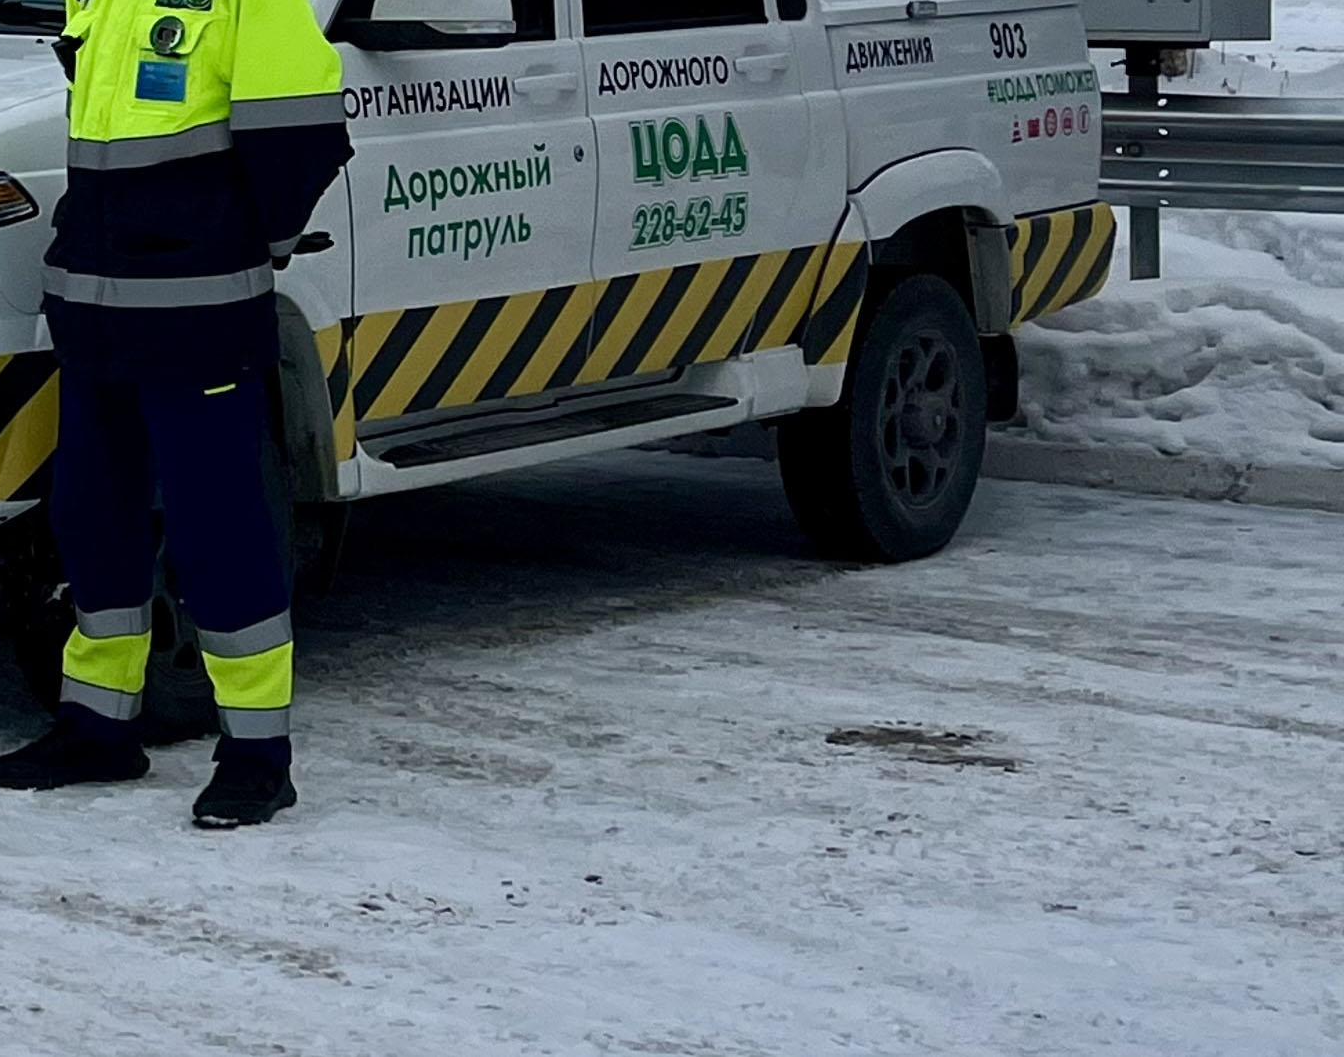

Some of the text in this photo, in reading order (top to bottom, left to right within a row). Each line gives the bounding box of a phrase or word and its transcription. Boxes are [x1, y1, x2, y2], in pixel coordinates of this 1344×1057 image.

[989, 22, 1028, 59] 903
[342, 36, 935, 119] ОРГАНИЗАЦИИ ДОРОЖНОГО ДВИЖЕНИЯ
[384, 143, 551, 213] Дорожный
[629, 111, 750, 186] ЦОДД
[408, 213, 532, 261] патруль
[629, 192, 749, 251] 228-62-45
